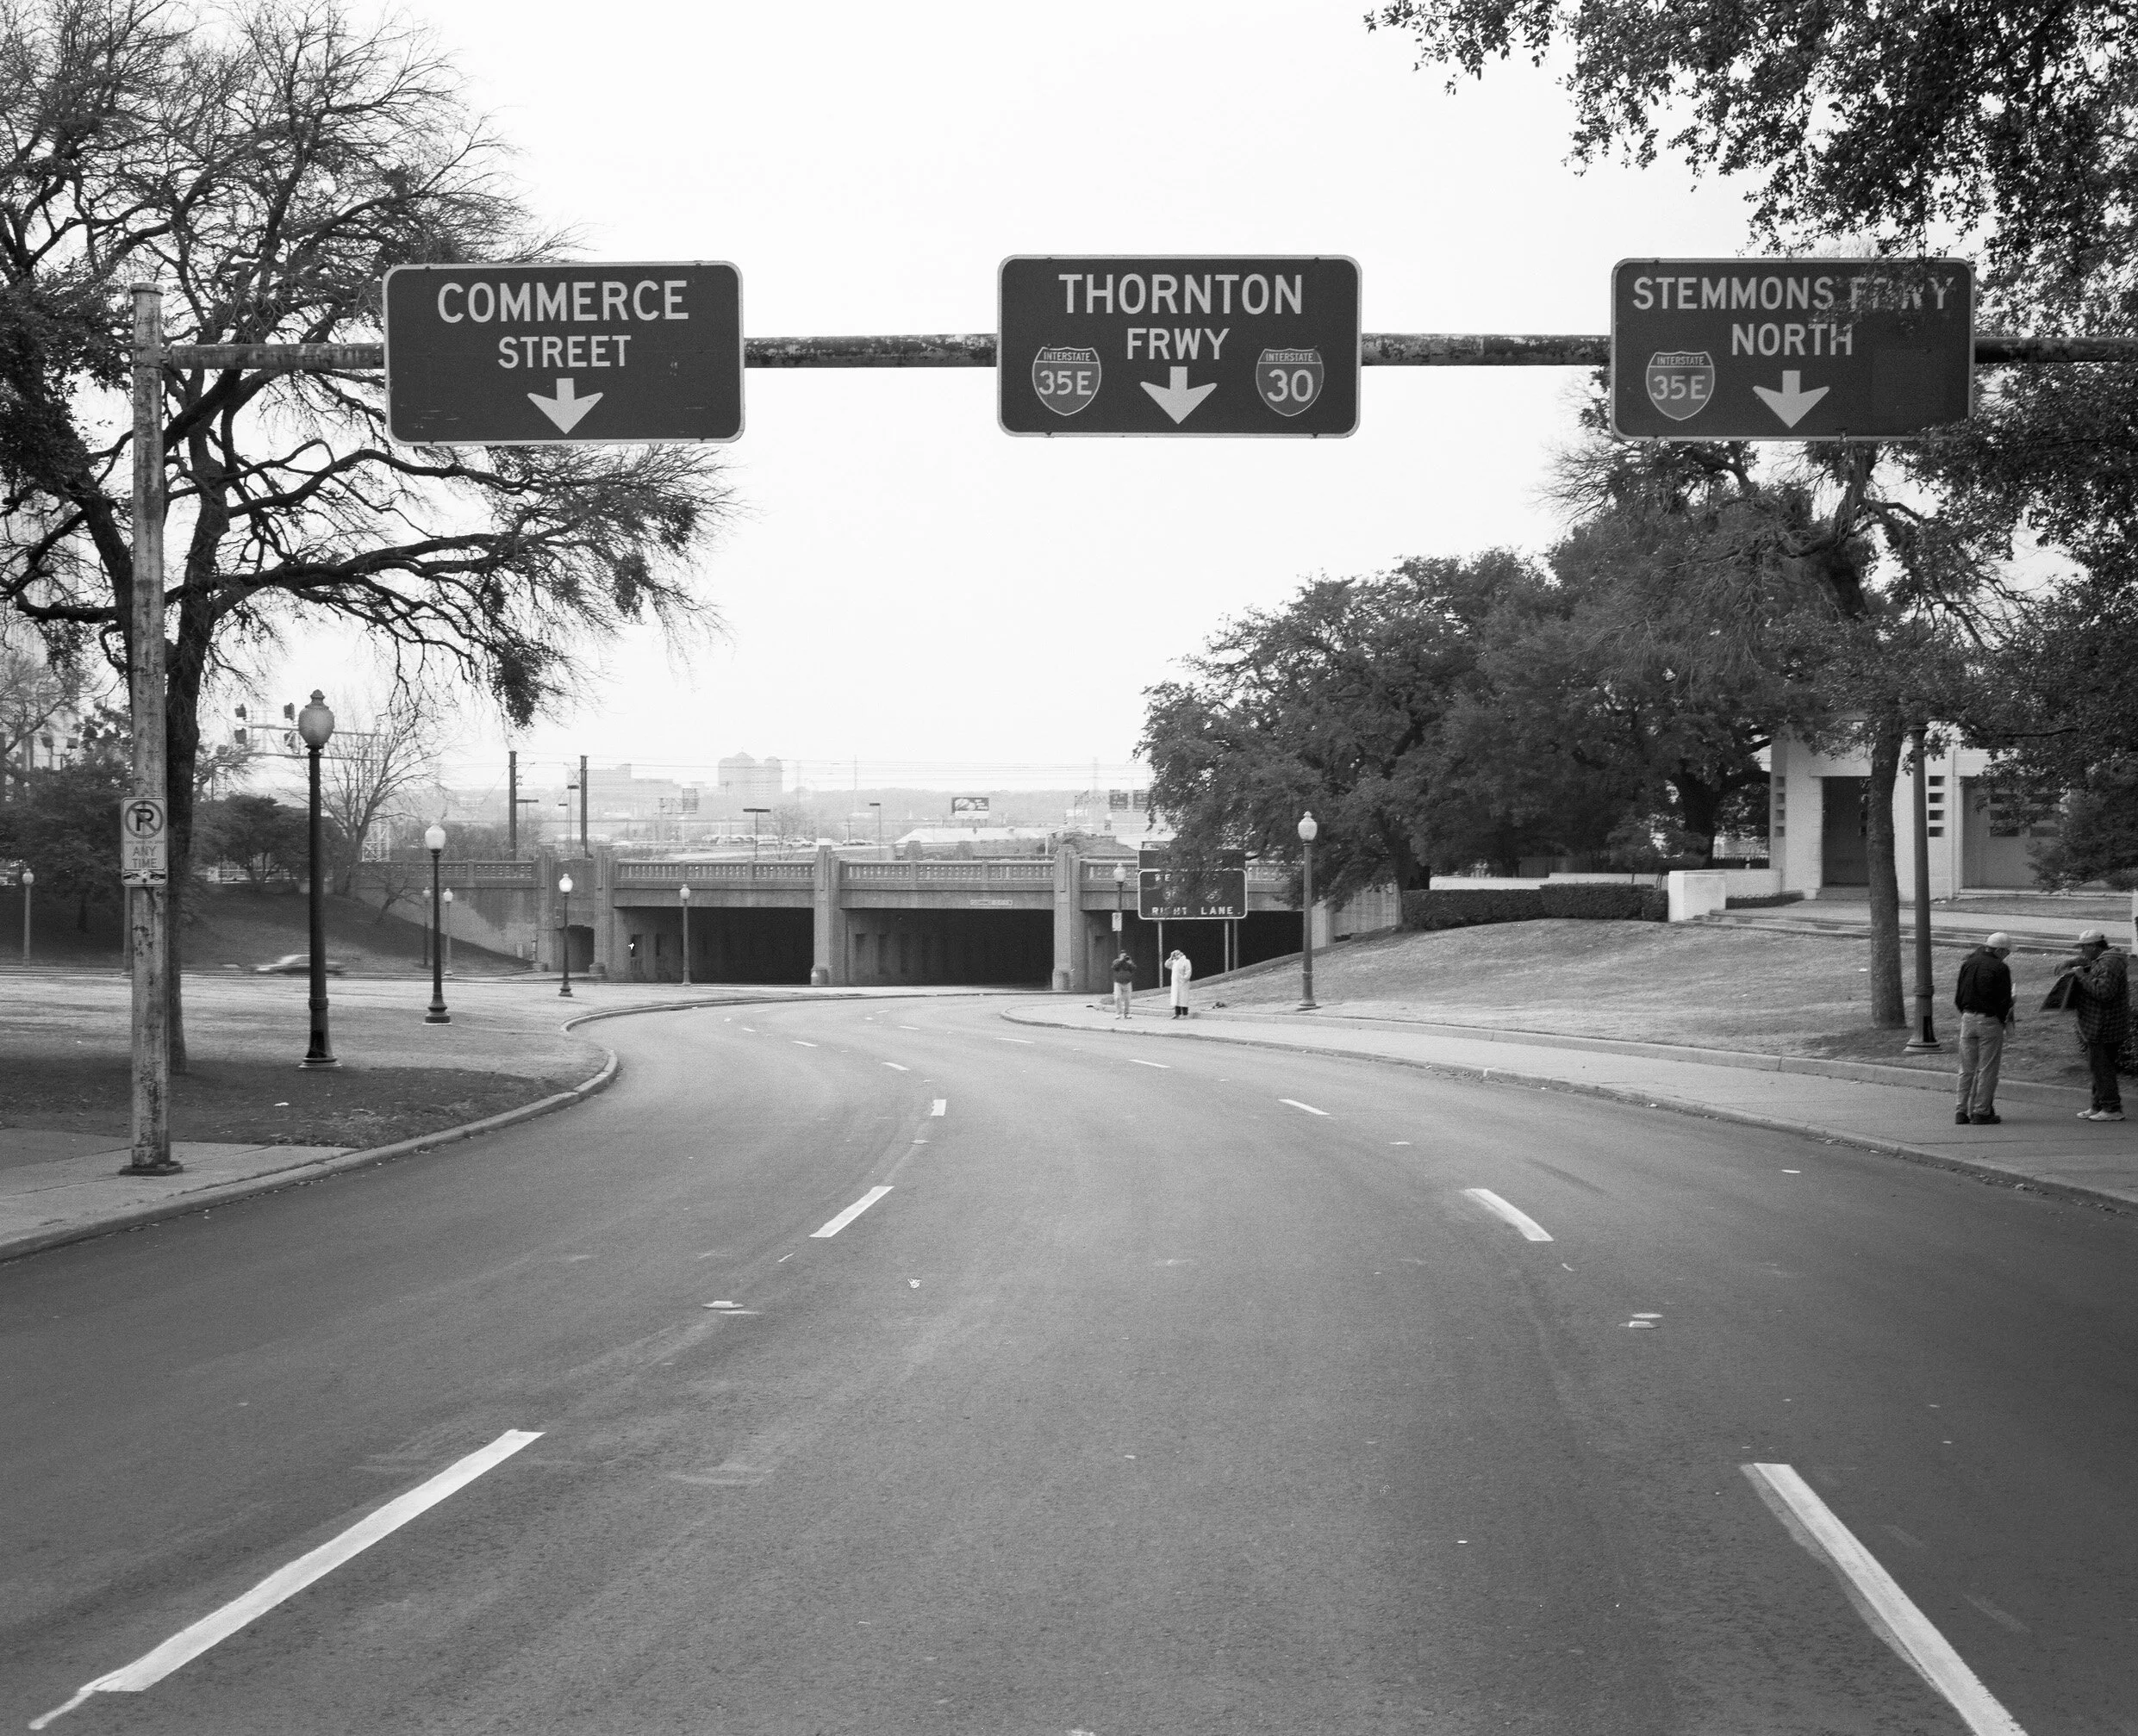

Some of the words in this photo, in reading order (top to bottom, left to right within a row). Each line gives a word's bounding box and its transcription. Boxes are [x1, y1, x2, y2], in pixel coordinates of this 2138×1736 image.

[437, 280, 689, 324] COMMERCE
[1058, 273, 1303, 315] THORNTON
[1632, 276, 1836, 310] STEMMONS
[497, 335, 632, 369] STREET
[1126, 327, 1231, 360] FRWY
[1731, 323, 1853, 356] NORTH
[1043, 352, 1091, 361] INTERSTATE
[1265, 352, 1314, 362] INTERSTATE
[1656, 356, 1705, 365] INTERSTATE
[1038, 370, 1093, 395] 35E
[1267, 369, 1314, 402] 30
[1652, 375, 1706, 400] 35E
[131, 858, 157, 868] TIME
[132, 846, 156, 856] ANY
[1151, 906, 1187, 915] RIHT
[1200, 905, 1234, 915] LANE
